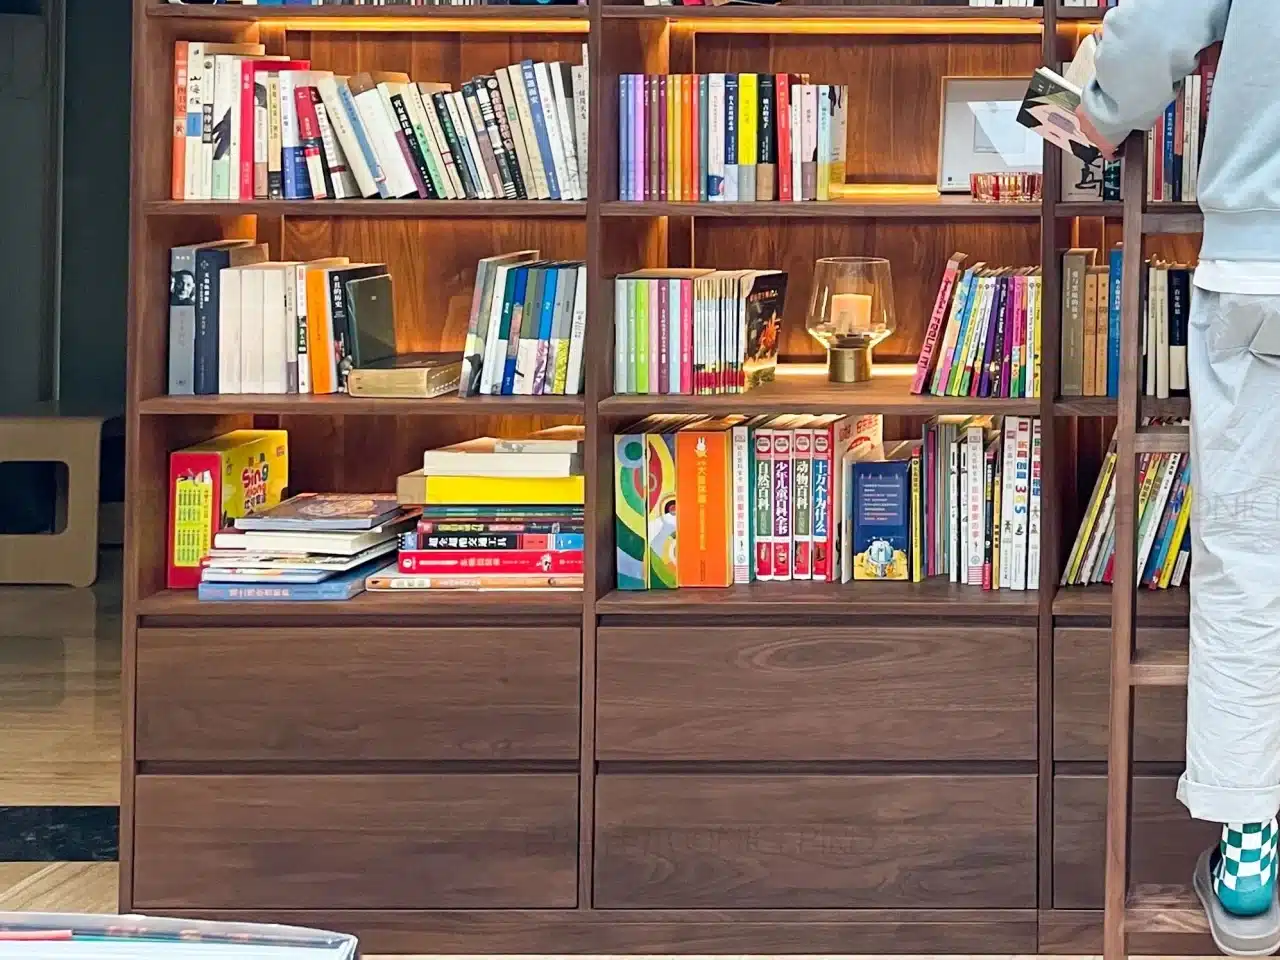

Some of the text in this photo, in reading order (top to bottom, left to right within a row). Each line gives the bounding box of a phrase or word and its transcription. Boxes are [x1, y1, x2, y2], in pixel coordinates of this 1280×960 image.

[240, 463, 269, 489] Sing
[757, 461, 771, 511] 自然百科
[775, 462, 790, 535] 少年儿童百科全书
[796, 461, 809, 510] 动物百科
[815, 463, 828, 534] 十万个为什么
